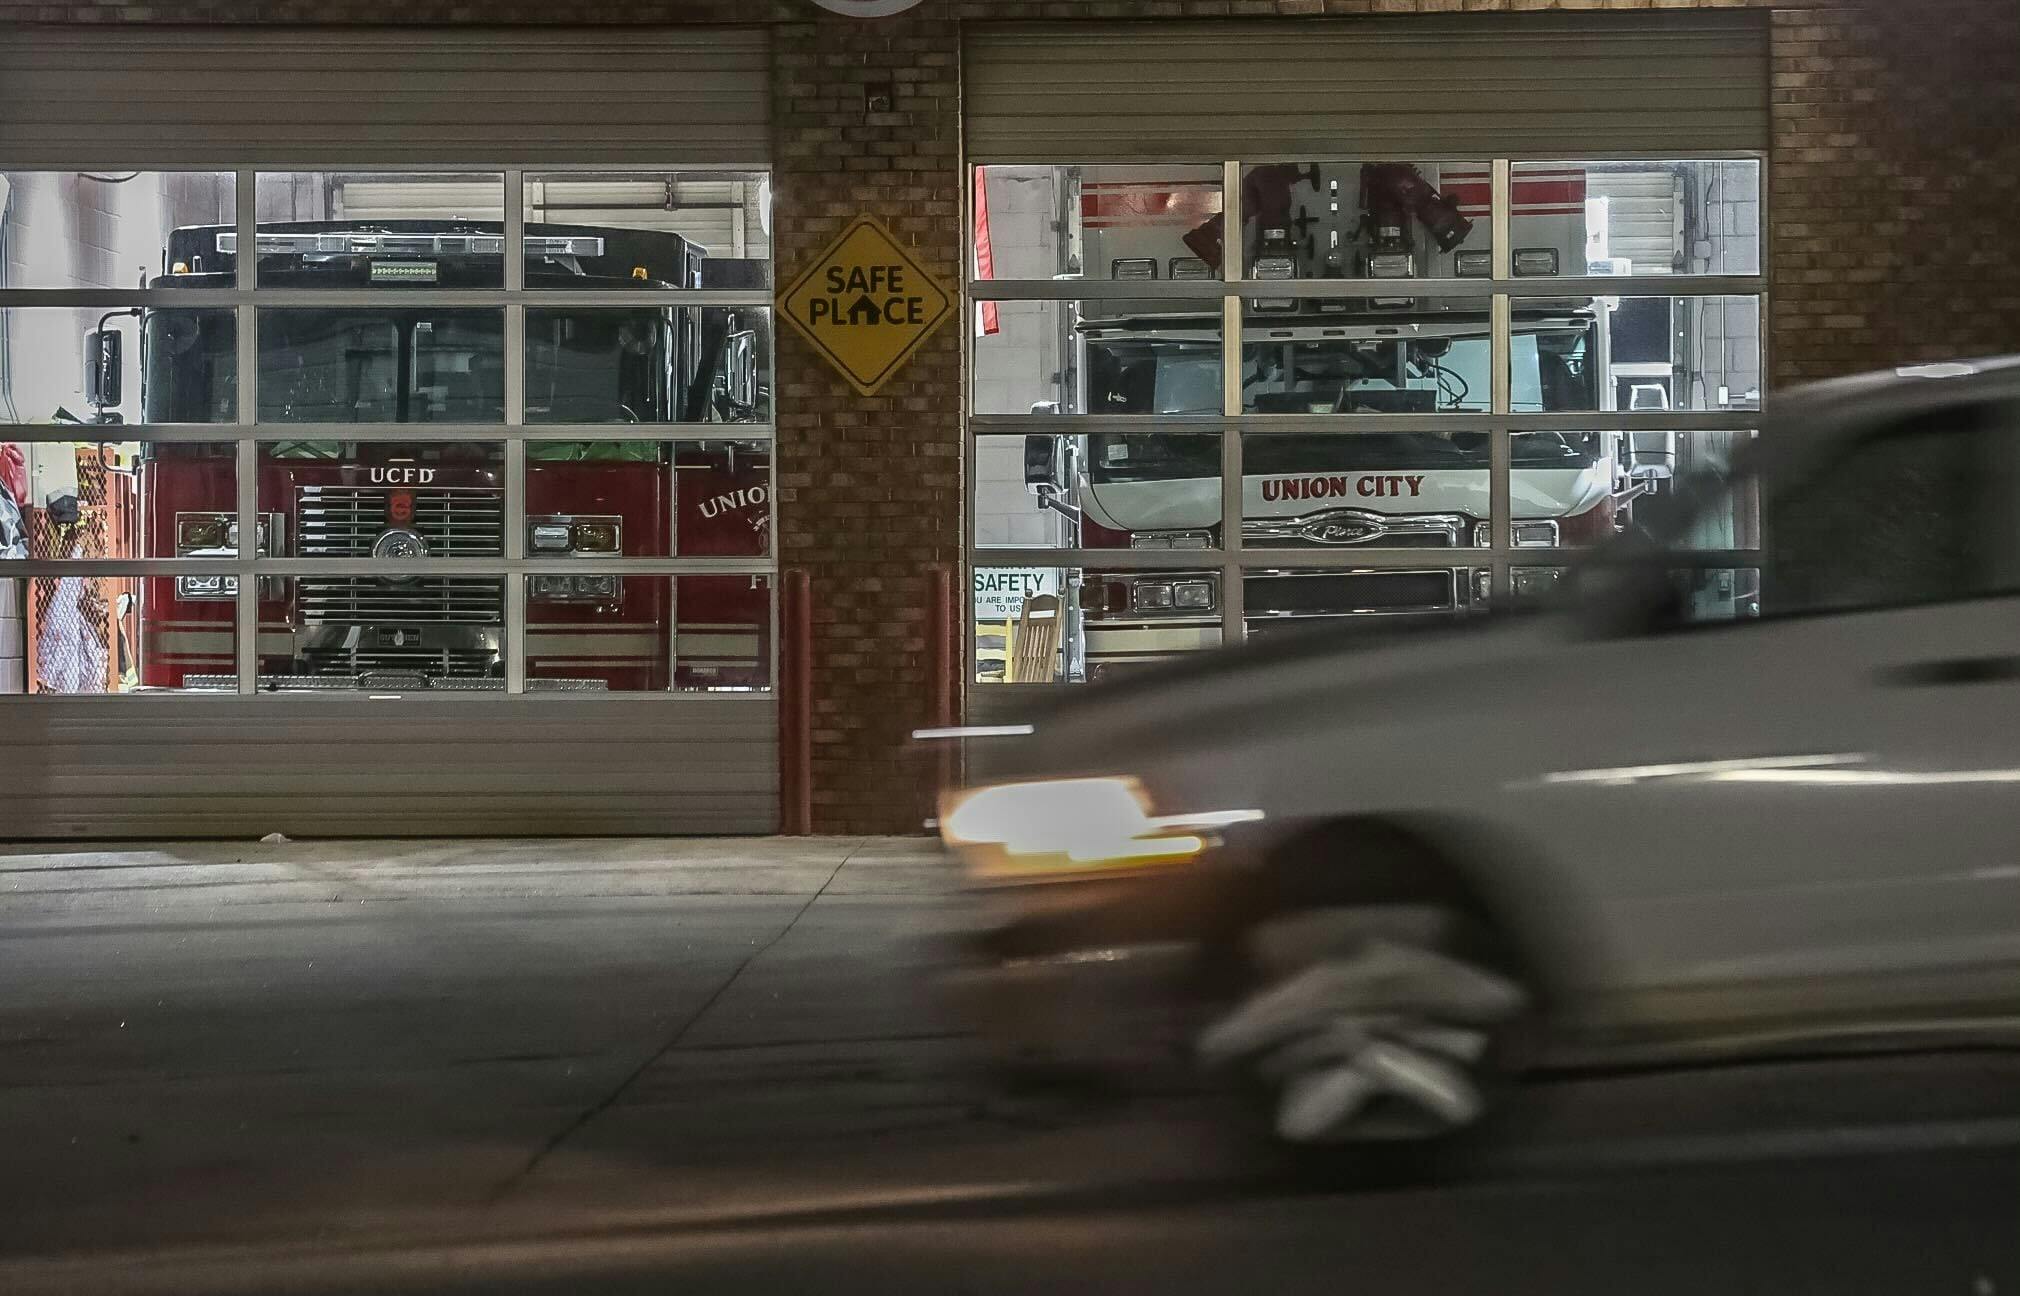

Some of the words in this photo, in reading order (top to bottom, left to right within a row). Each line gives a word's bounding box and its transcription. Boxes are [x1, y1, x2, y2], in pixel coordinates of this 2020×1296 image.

[826, 265, 904, 293] SAFE
[370, 467, 435, 483] UCFD
[1262, 476, 1348, 501] UNION
[1357, 475, 1425, 497] CITY
[975, 573, 1044, 591] SAFETY
[986, 596, 1001, 604] ARE
[995, 604, 1006, 613] TO
